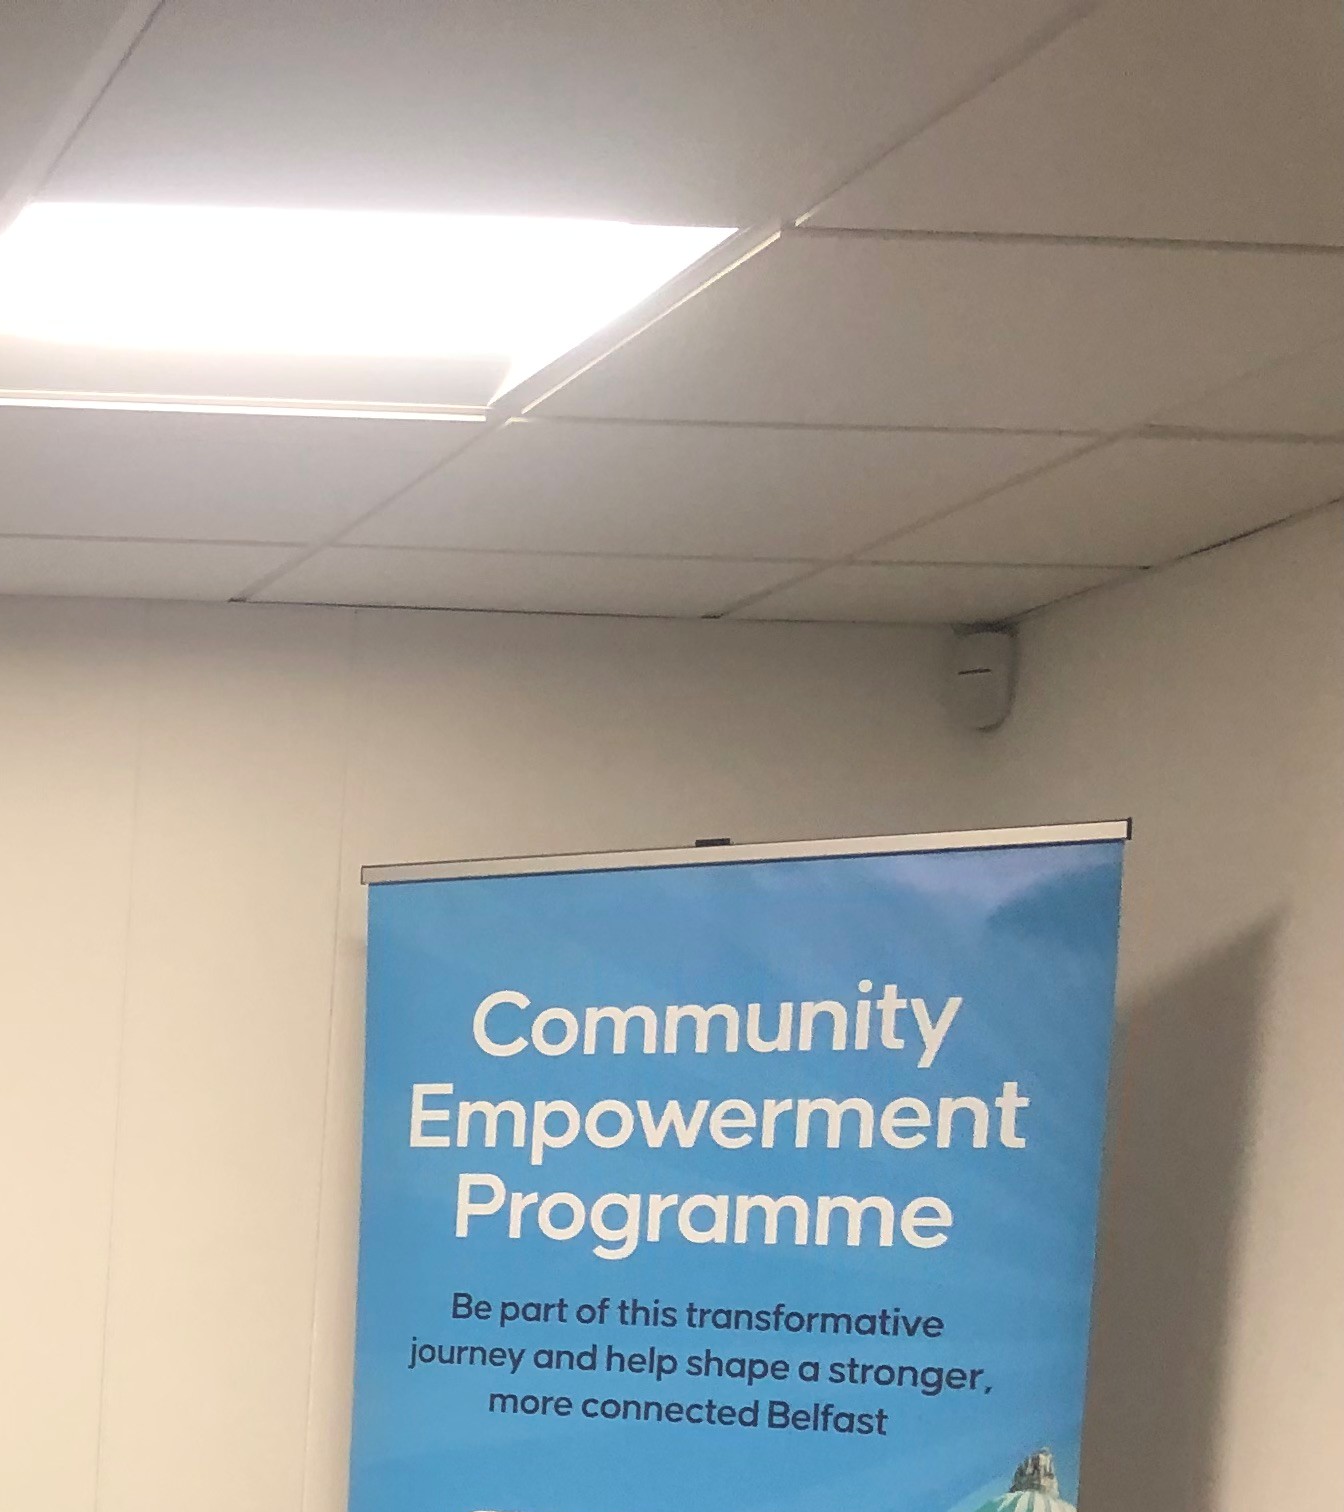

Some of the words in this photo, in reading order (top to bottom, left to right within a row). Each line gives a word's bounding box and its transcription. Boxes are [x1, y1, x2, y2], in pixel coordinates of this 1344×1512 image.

[472, 979, 963, 1069] Community
[409, 1081, 1031, 1166] Empowerment
[455, 1172, 953, 1260] Programme
[451, 1292, 493, 1321] Be
[499, 1297, 569, 1328] part
[575, 1297, 611, 1325] of
[616, 1299, 678, 1328] this
[685, 1302, 945, 1338] transformative
[407, 1336, 527, 1375] journey
[533, 1343, 598, 1371] and
[606, 1344, 679, 1382] help
[685, 1348, 790, 1387] shape
[798, 1361, 820, 1383] a
[828, 1357, 993, 1397] stronger,
[488, 1392, 573, 1417] more
[581, 1398, 760, 1428] connected
[767, 1400, 890, 1436] Belfast
